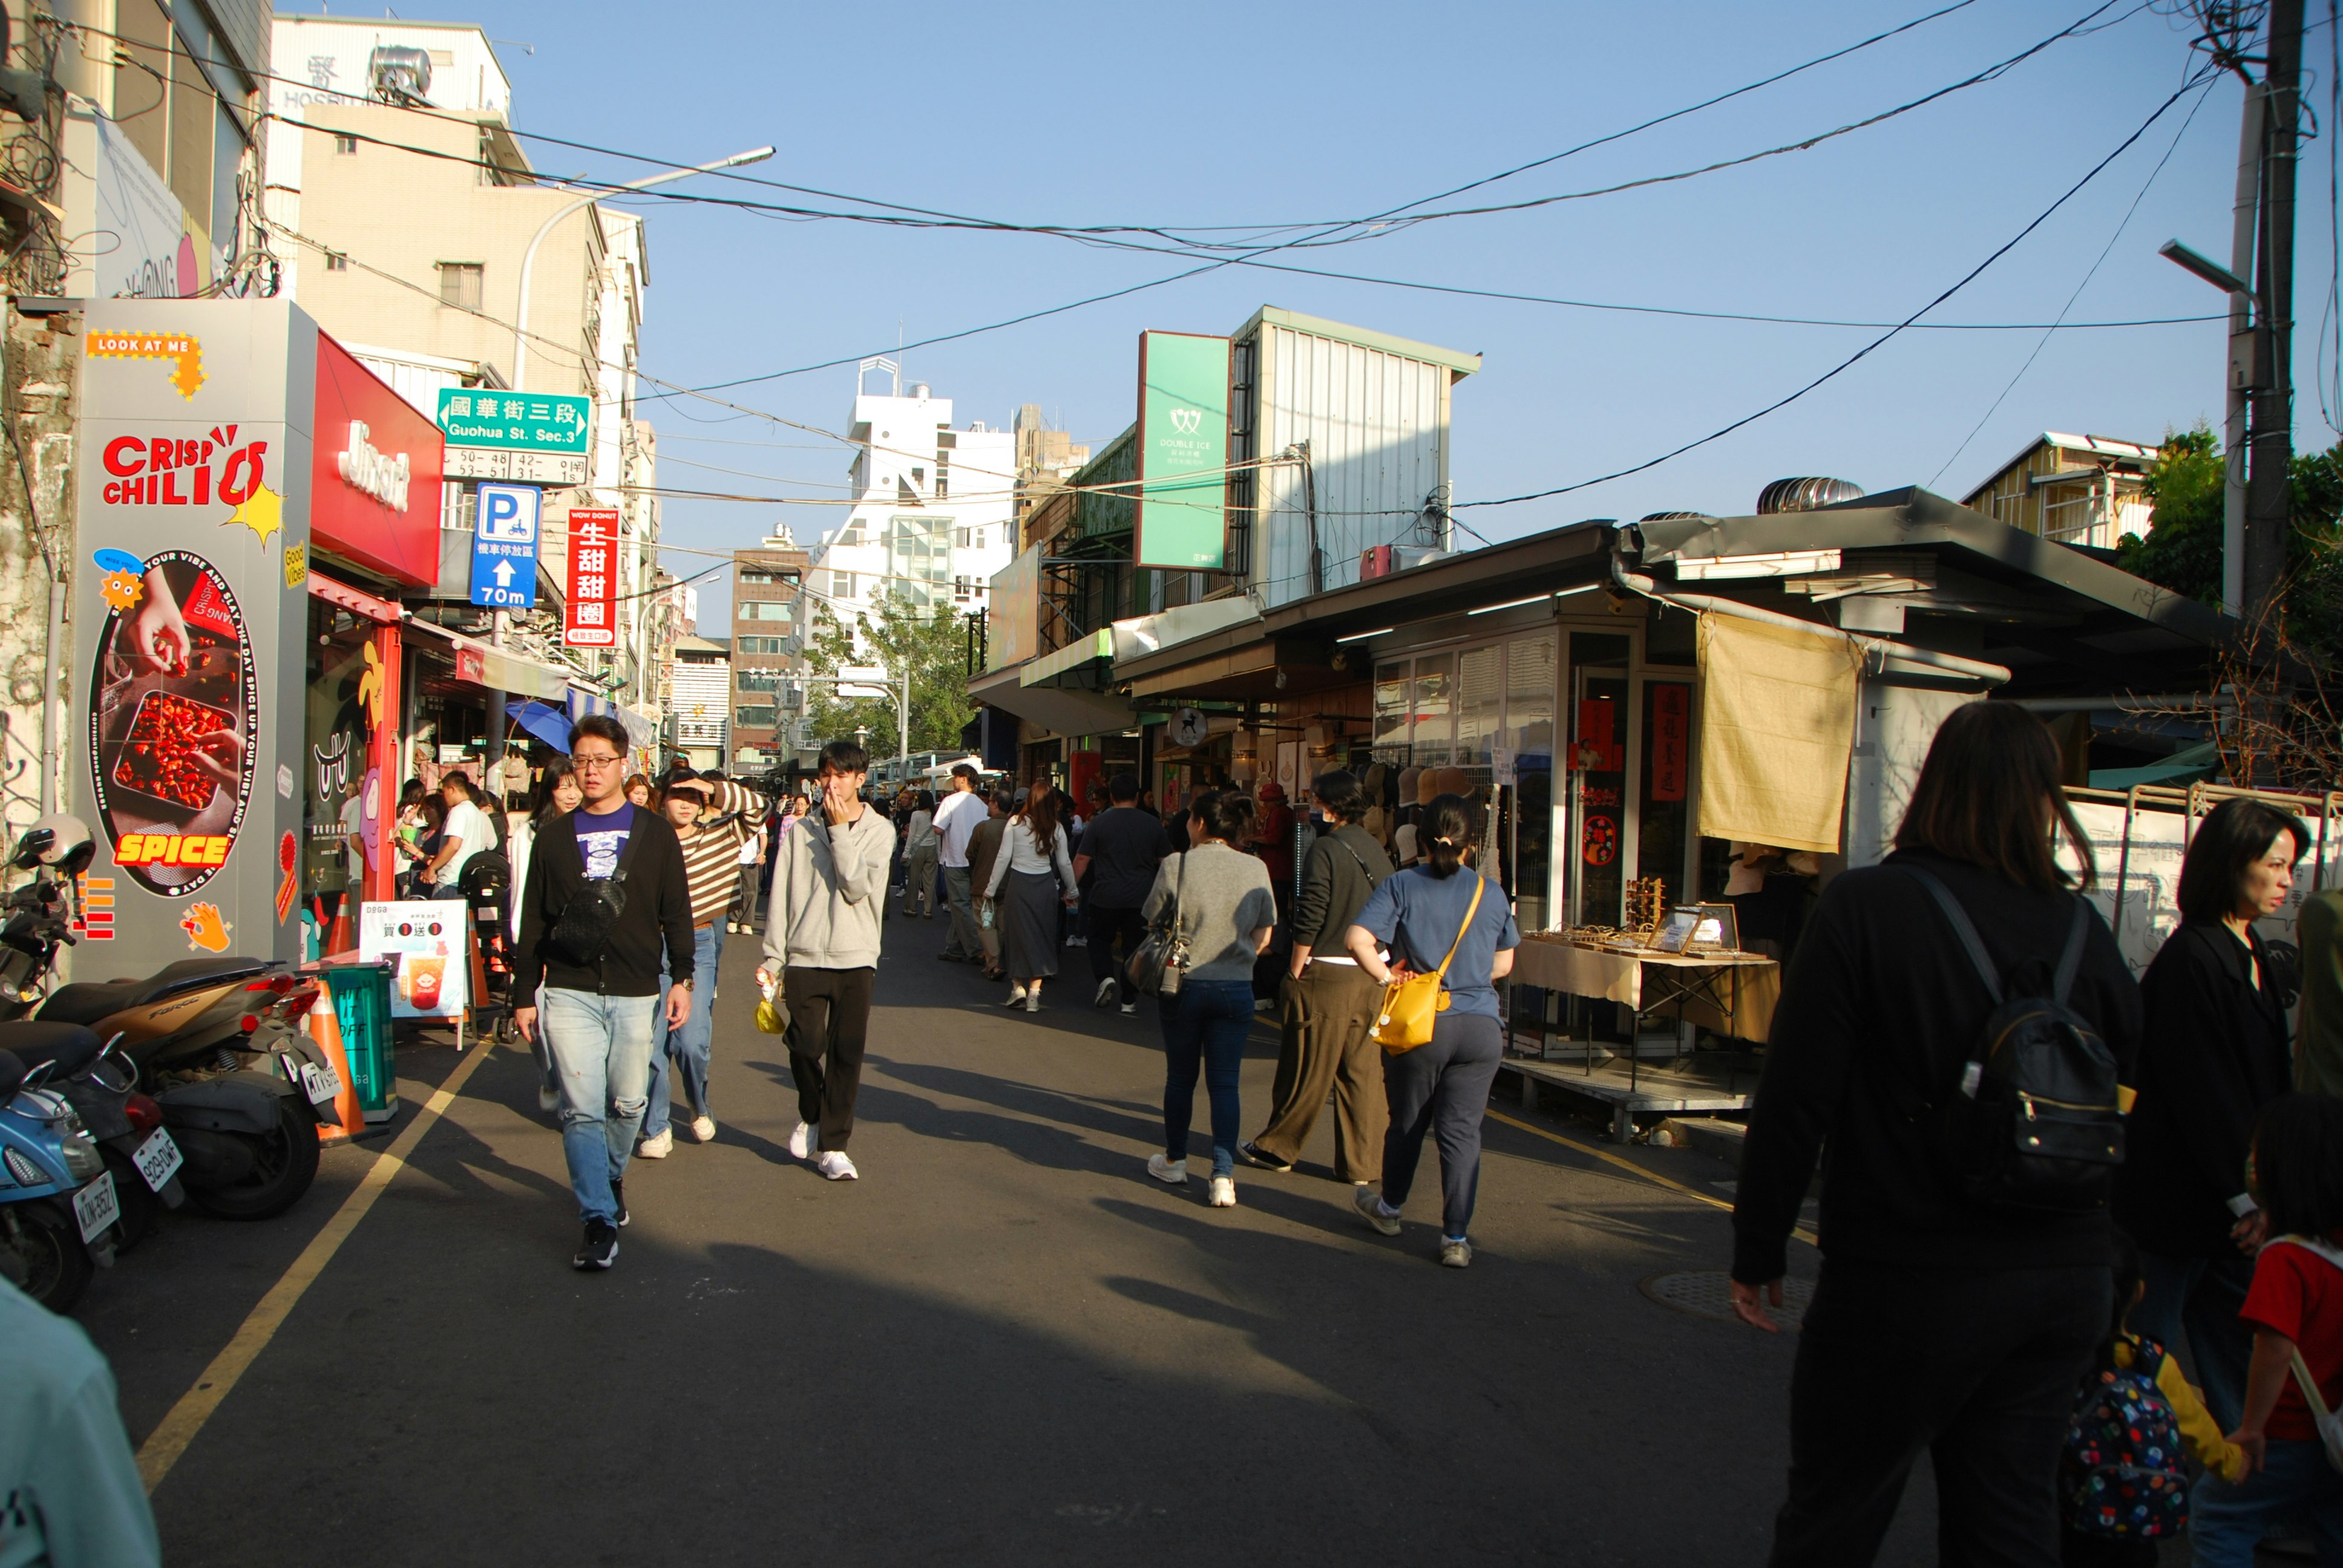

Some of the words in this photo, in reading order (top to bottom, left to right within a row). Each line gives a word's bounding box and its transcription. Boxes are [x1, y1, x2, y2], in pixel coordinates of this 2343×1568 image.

[99, 339, 139, 351] LOOK
[144, 340, 163, 351] AT
[168, 341, 189, 352] ME
[450, 396, 576, 424] 國華街三段
[448, 423, 503, 439] Guohua
[509, 428, 529, 440] St.
[536, 428, 575, 443] Sec.3
[1160, 439, 1194, 449] DOUBLE
[1197, 440, 1210, 449] ICE
[103, 436, 214, 477] CRISP
[460, 451, 484, 462] 50-
[491, 454, 506, 464] 48
[519, 455, 543, 466] 42-
[459, 465, 483, 477] 53-
[490, 466, 506, 478] 51
[517, 468, 542, 479] 31-
[103, 465, 211, 505] CHILI
[486, 493, 519, 534] P
[286, 544, 303, 566] Good
[477, 543, 534, 558] 機車停放區
[105, 556, 120, 565] MISS
[144, 552, 176, 570] YOUR
[180, 552, 208, 570] VIBE
[206, 569, 226, 590] AND
[286, 566, 305, 585] Vibes
[577, 522, 607, 626] 生甜甜圈
[481, 587, 525, 604] 70m
[223, 592, 241, 620] SLAY
[236, 622, 248, 645] THE
[243, 648, 254, 673] DAY
[246, 676, 257, 710] SPICE
[248, 714, 257, 730] UP
[245, 734, 256, 766] YOUR
[240, 770, 252, 797] VIBE
[233, 799, 246, 825] AND
[117, 834, 229, 864] SPICE
[183, 875, 206, 893] DAY
[384, 927, 395, 938] 買
[414, 926, 425, 937] 送
[336, 987, 361, 1000] HIT
[343, 1005, 357, 1018] IT
